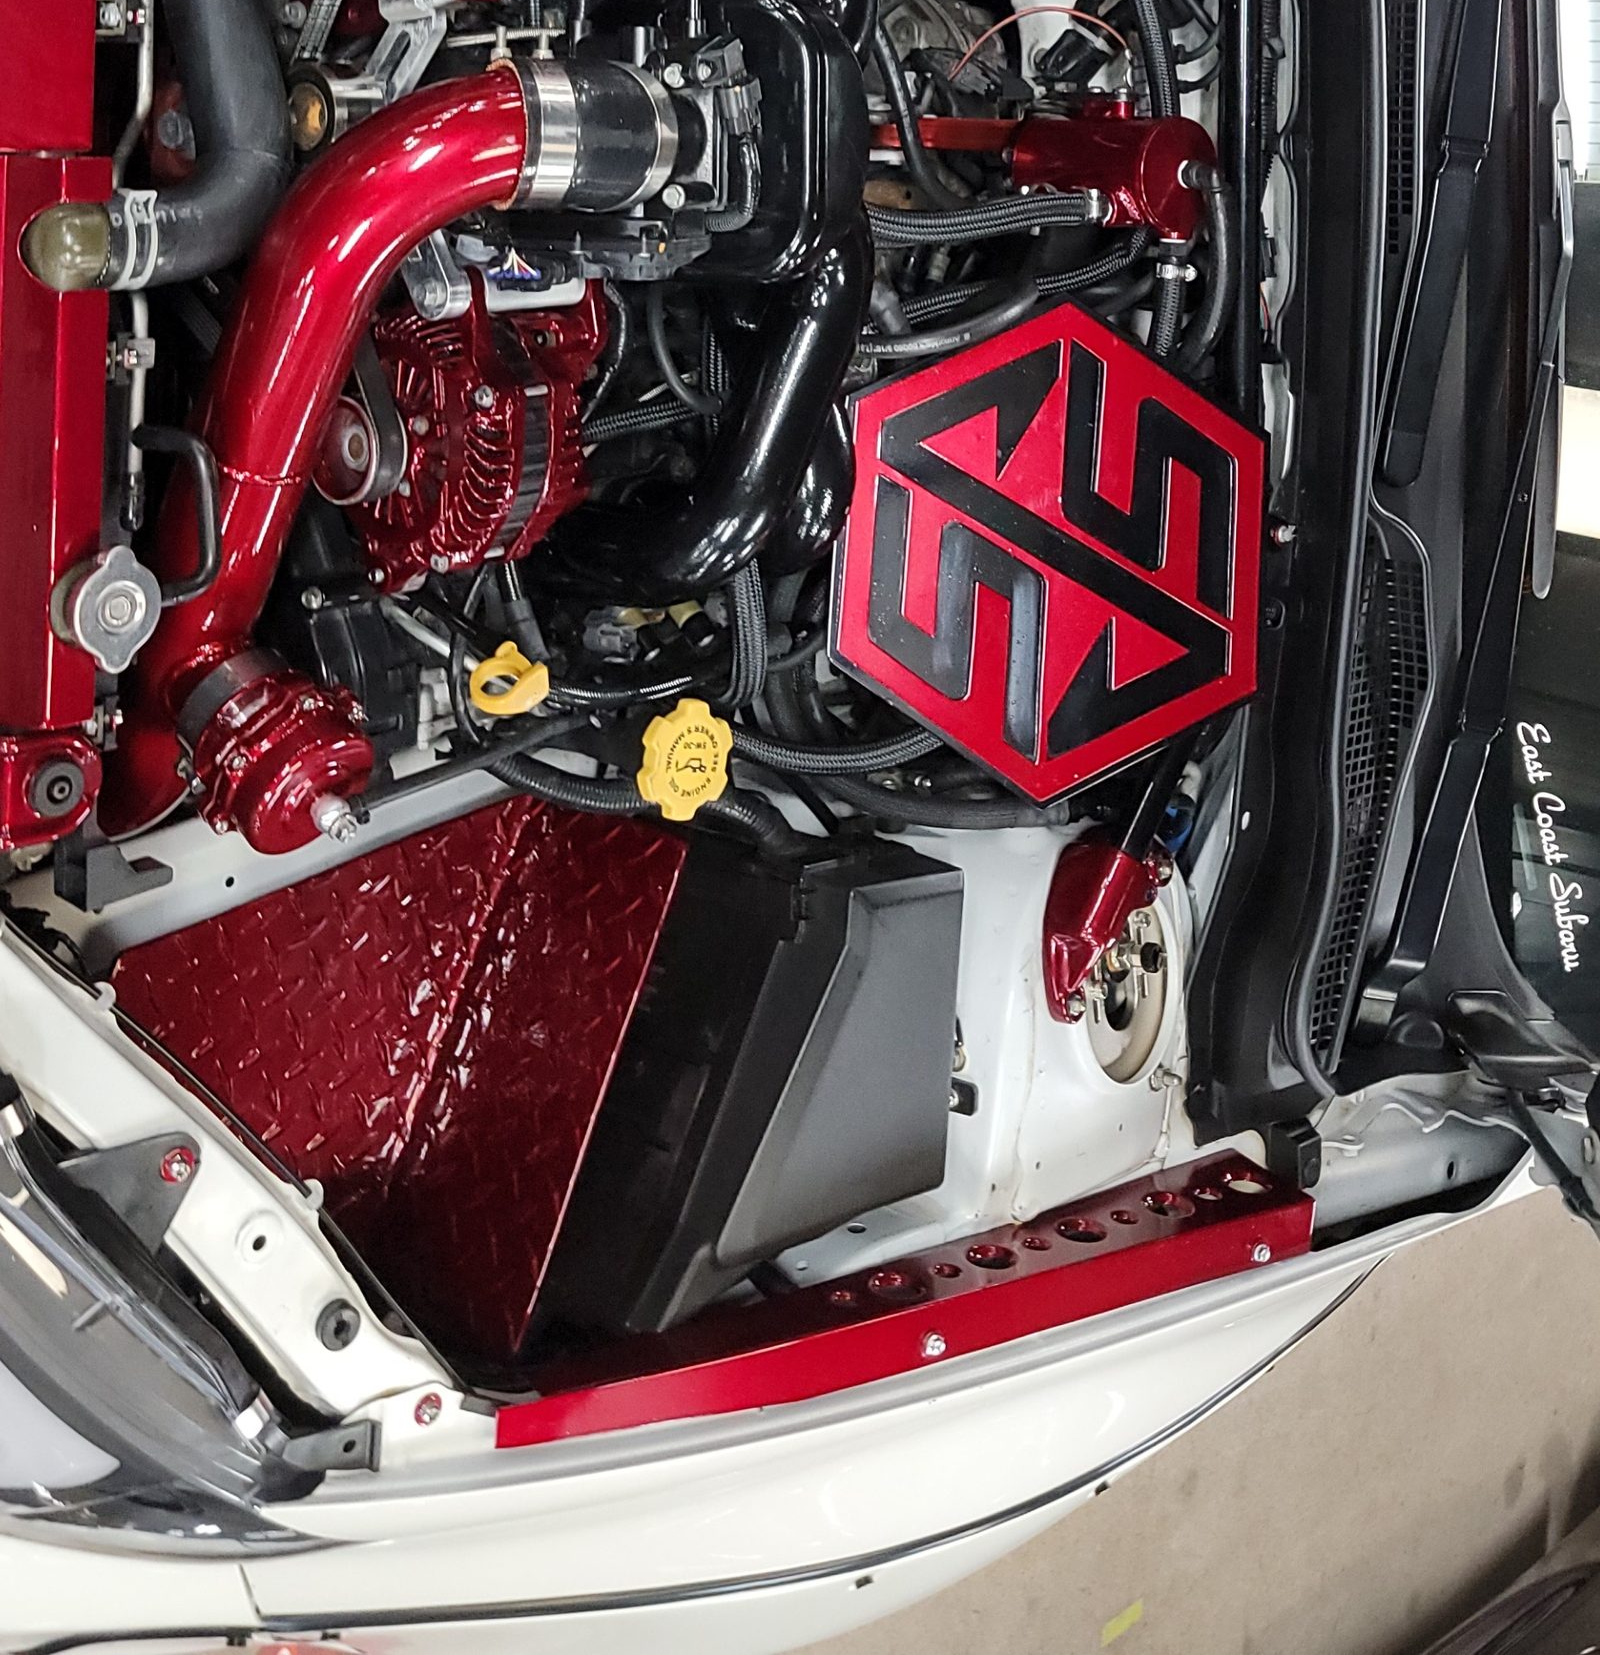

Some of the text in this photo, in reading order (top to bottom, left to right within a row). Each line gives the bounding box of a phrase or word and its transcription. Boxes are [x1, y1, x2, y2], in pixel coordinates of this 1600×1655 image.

[665, 731, 685, 773] MANUAL
[711, 752, 719, 772] SEE
[680, 777, 712, 797] ENGINE
[1517, 721, 1590, 973] East Coast Subaru
